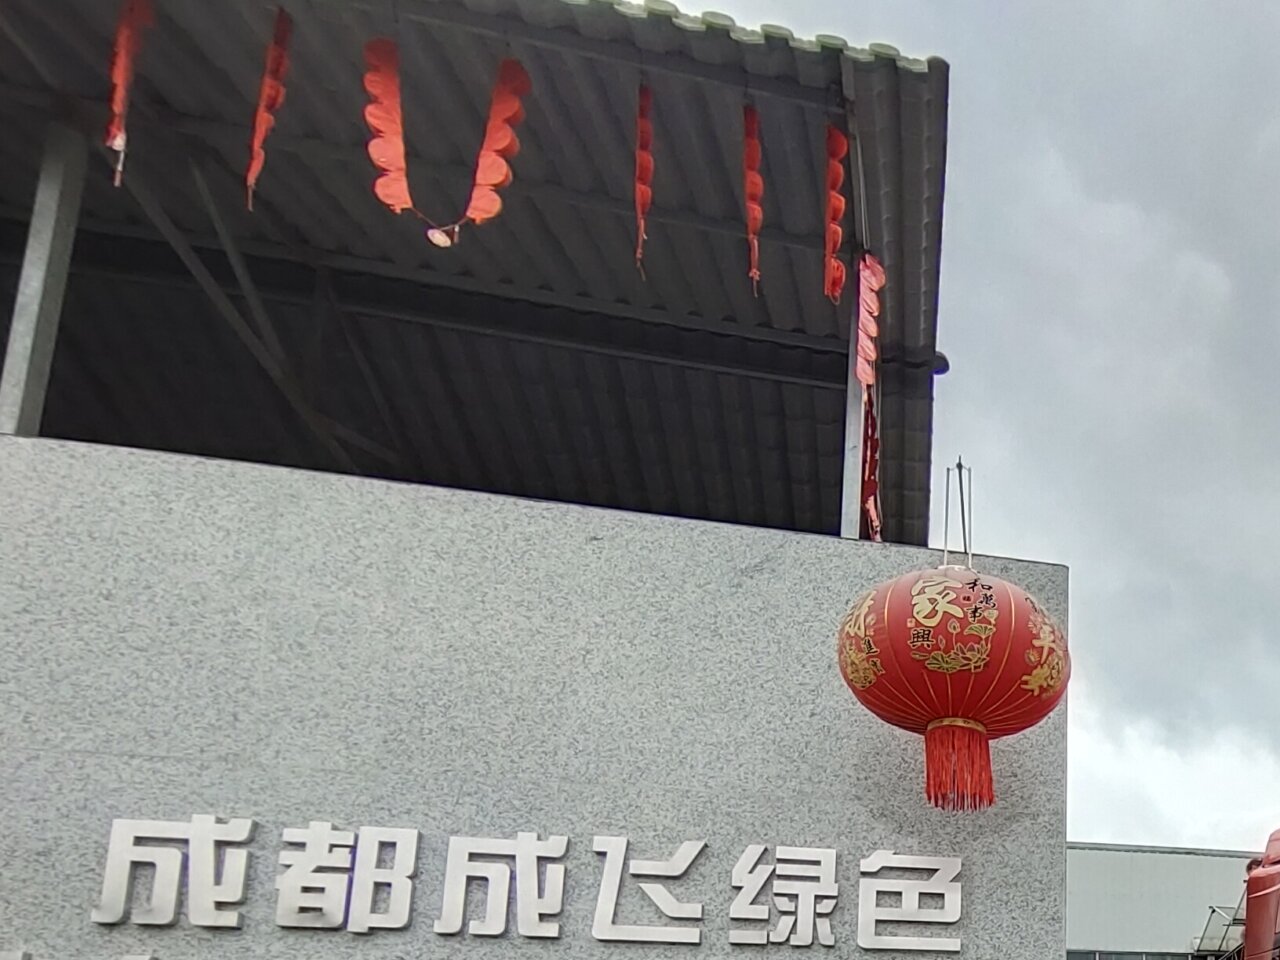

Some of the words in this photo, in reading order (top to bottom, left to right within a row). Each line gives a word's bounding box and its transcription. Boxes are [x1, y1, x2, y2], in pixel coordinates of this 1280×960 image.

[90, 814, 964, 952] 成都成飞绿色
